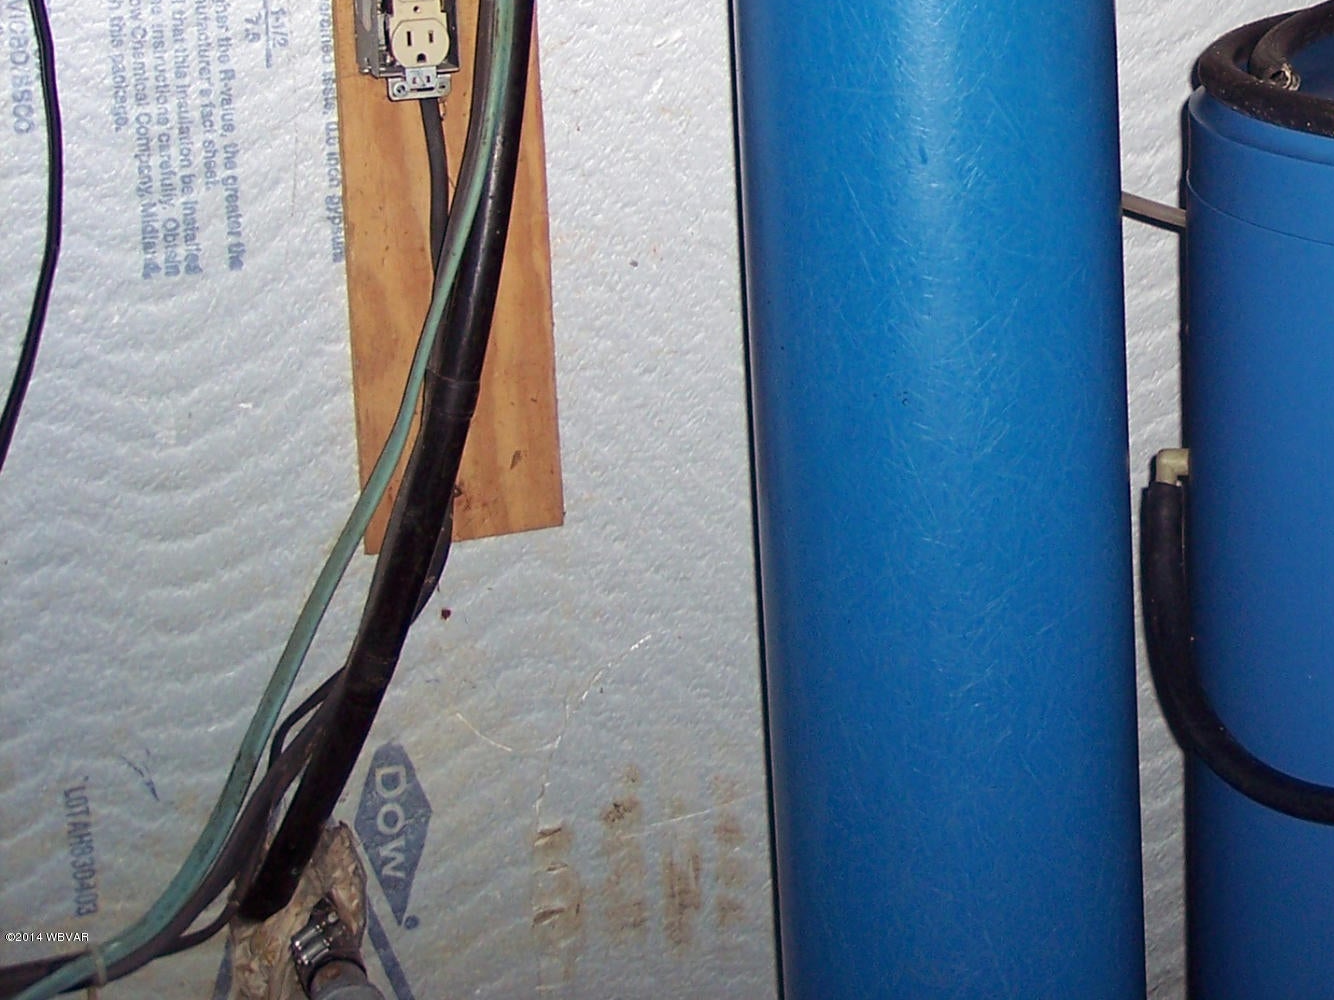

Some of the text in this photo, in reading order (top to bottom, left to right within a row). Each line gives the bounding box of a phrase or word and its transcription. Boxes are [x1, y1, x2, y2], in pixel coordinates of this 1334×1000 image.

[109, 16, 125, 48] this
[171, 9, 187, 43] that
[216, 36, 234, 64] the
[176, 84, 194, 169] insulation
[223, 142, 239, 170] the
[180, 174, 197, 198] be
[221, 175, 243, 237] greater
[375, 764, 407, 879] DOW
